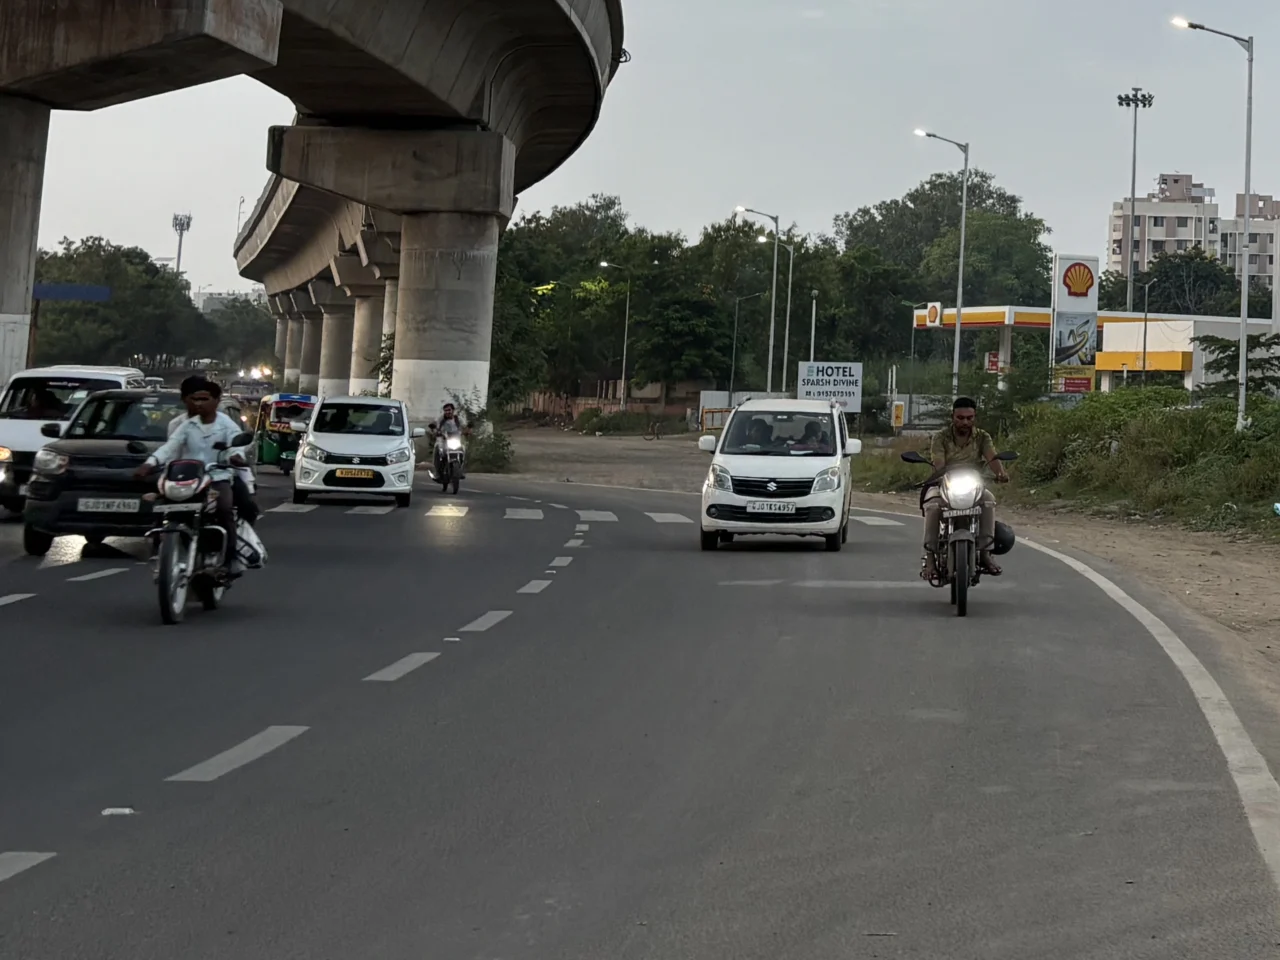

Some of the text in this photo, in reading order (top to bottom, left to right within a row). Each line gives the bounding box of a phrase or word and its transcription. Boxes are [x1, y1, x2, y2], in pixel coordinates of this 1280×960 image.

[816, 366, 855, 377] HOTEL
[802, 378, 859, 387] SPARSH DIVINE
